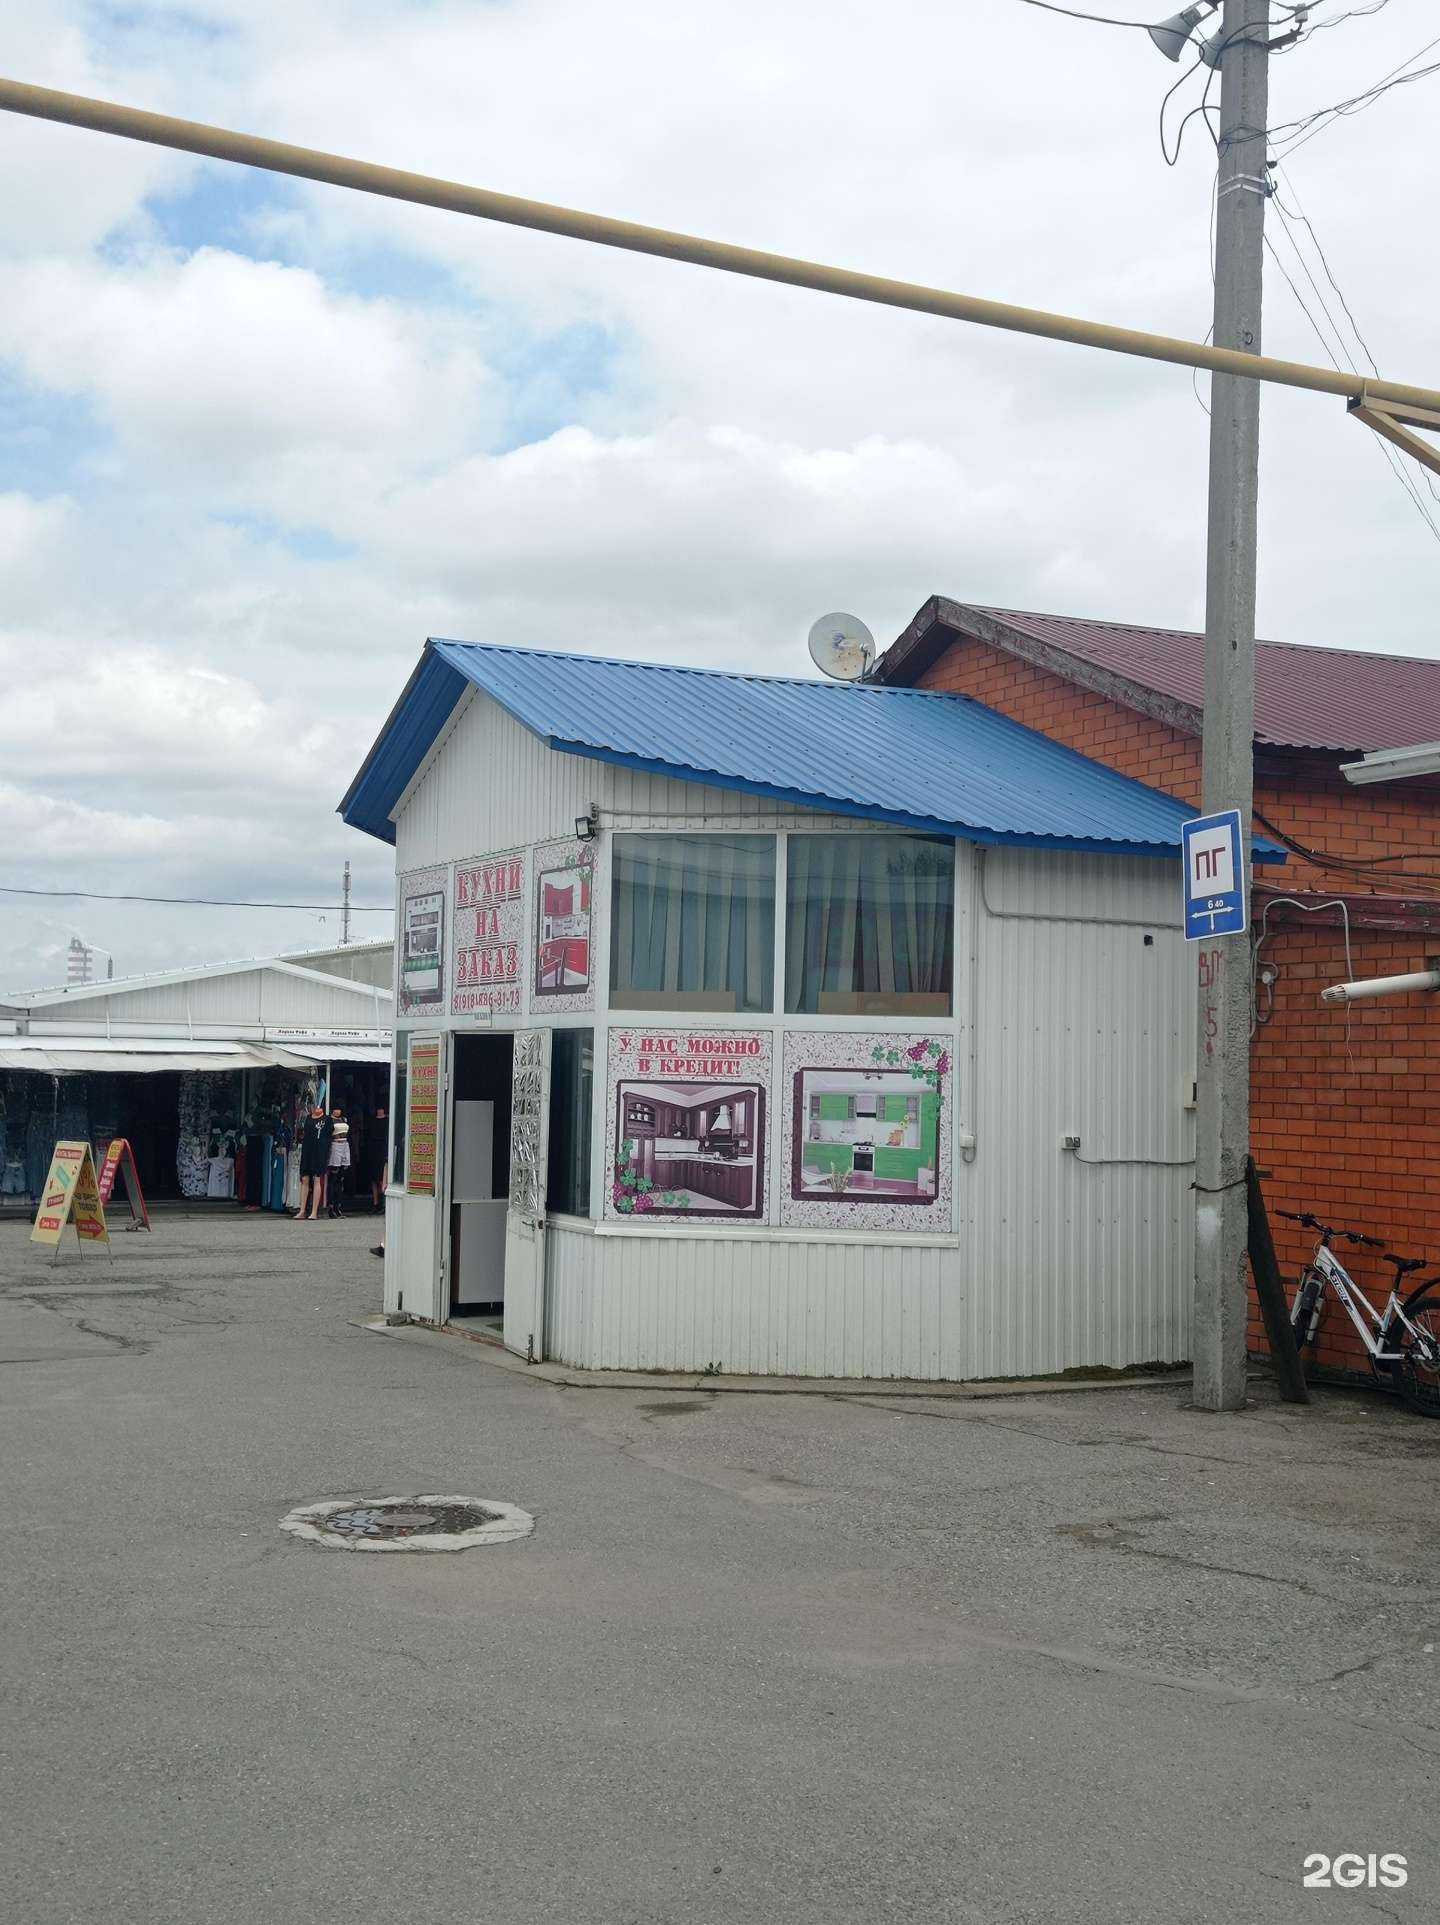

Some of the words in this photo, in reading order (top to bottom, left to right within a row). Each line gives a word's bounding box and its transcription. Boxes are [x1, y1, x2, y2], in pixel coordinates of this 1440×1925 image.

[1196, 847, 1226, 880] ПГ
[457, 861, 522, 903] КУХНИ
[1207, 900, 1214, 909] 6
[475, 909, 499, 937] НА
[457, 946, 518, 980] ЗАКАЗ
[619, 1037, 632, 1052] У
[641, 1038, 678, 1053] НАС
[687, 1038, 761, 1055] МОЖНО
[638, 1058, 651, 1072] В
[660, 1058, 741, 1075] КРЕДИТ!
